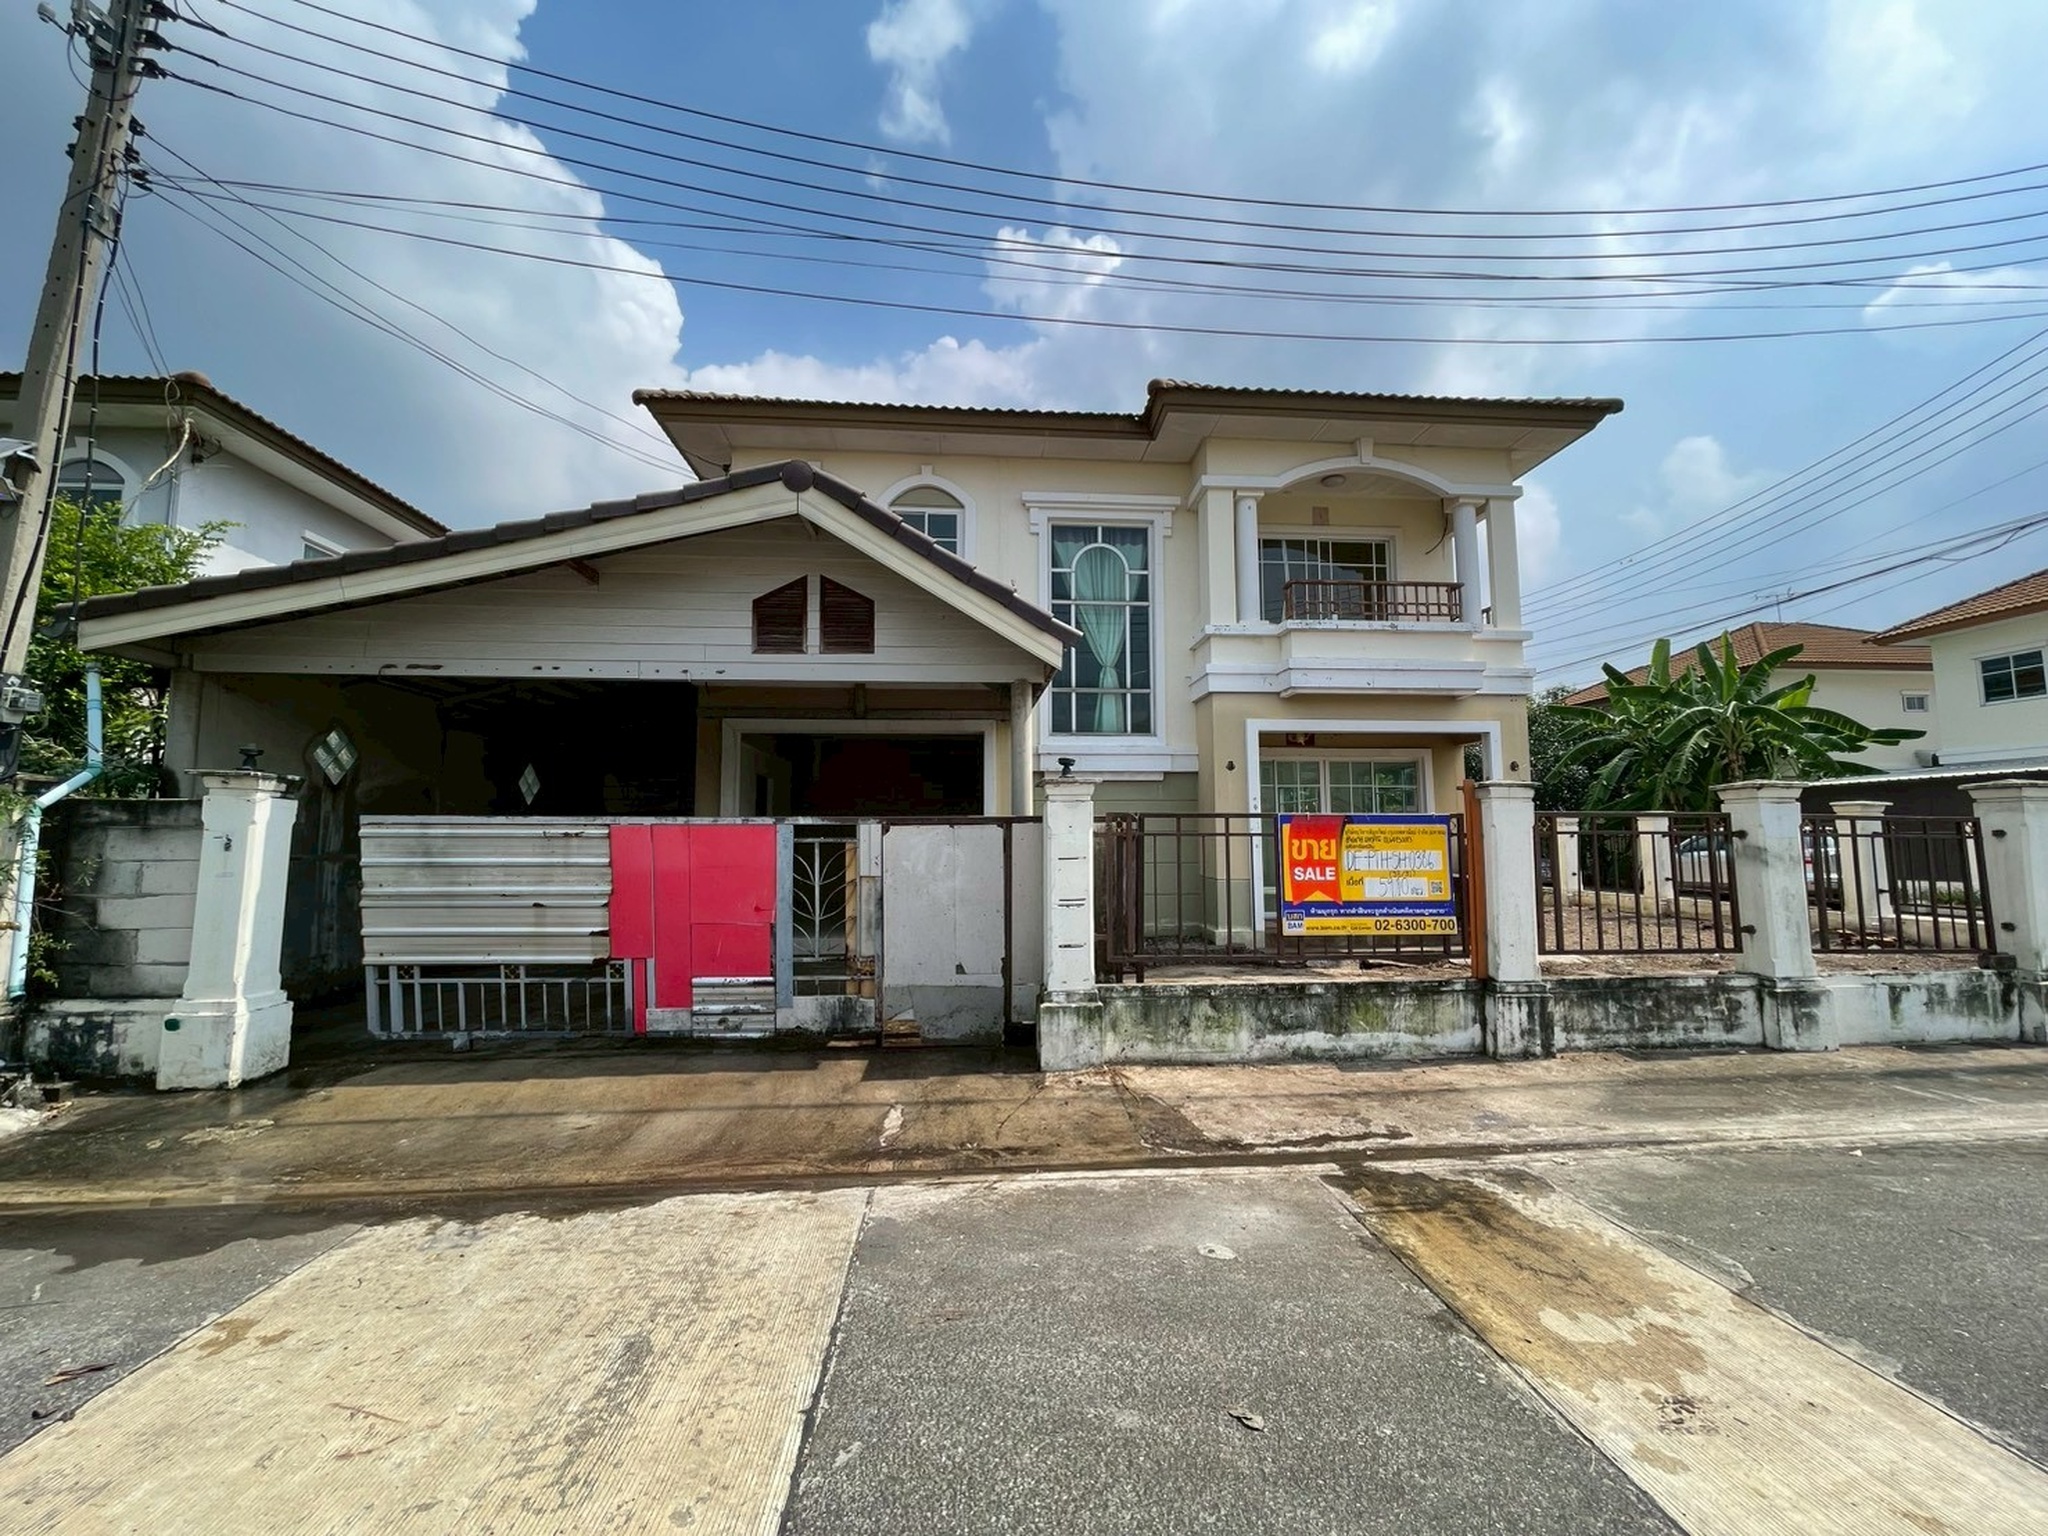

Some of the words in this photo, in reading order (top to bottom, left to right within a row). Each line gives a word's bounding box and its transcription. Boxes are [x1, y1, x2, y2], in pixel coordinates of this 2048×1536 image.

[1291, 838, 1336, 860] ขาย
[1293, 866, 1336, 881] SALE
[1287, 921, 1303, 930] BAM
[1374, 918, 1456, 931] 02-6300-700
